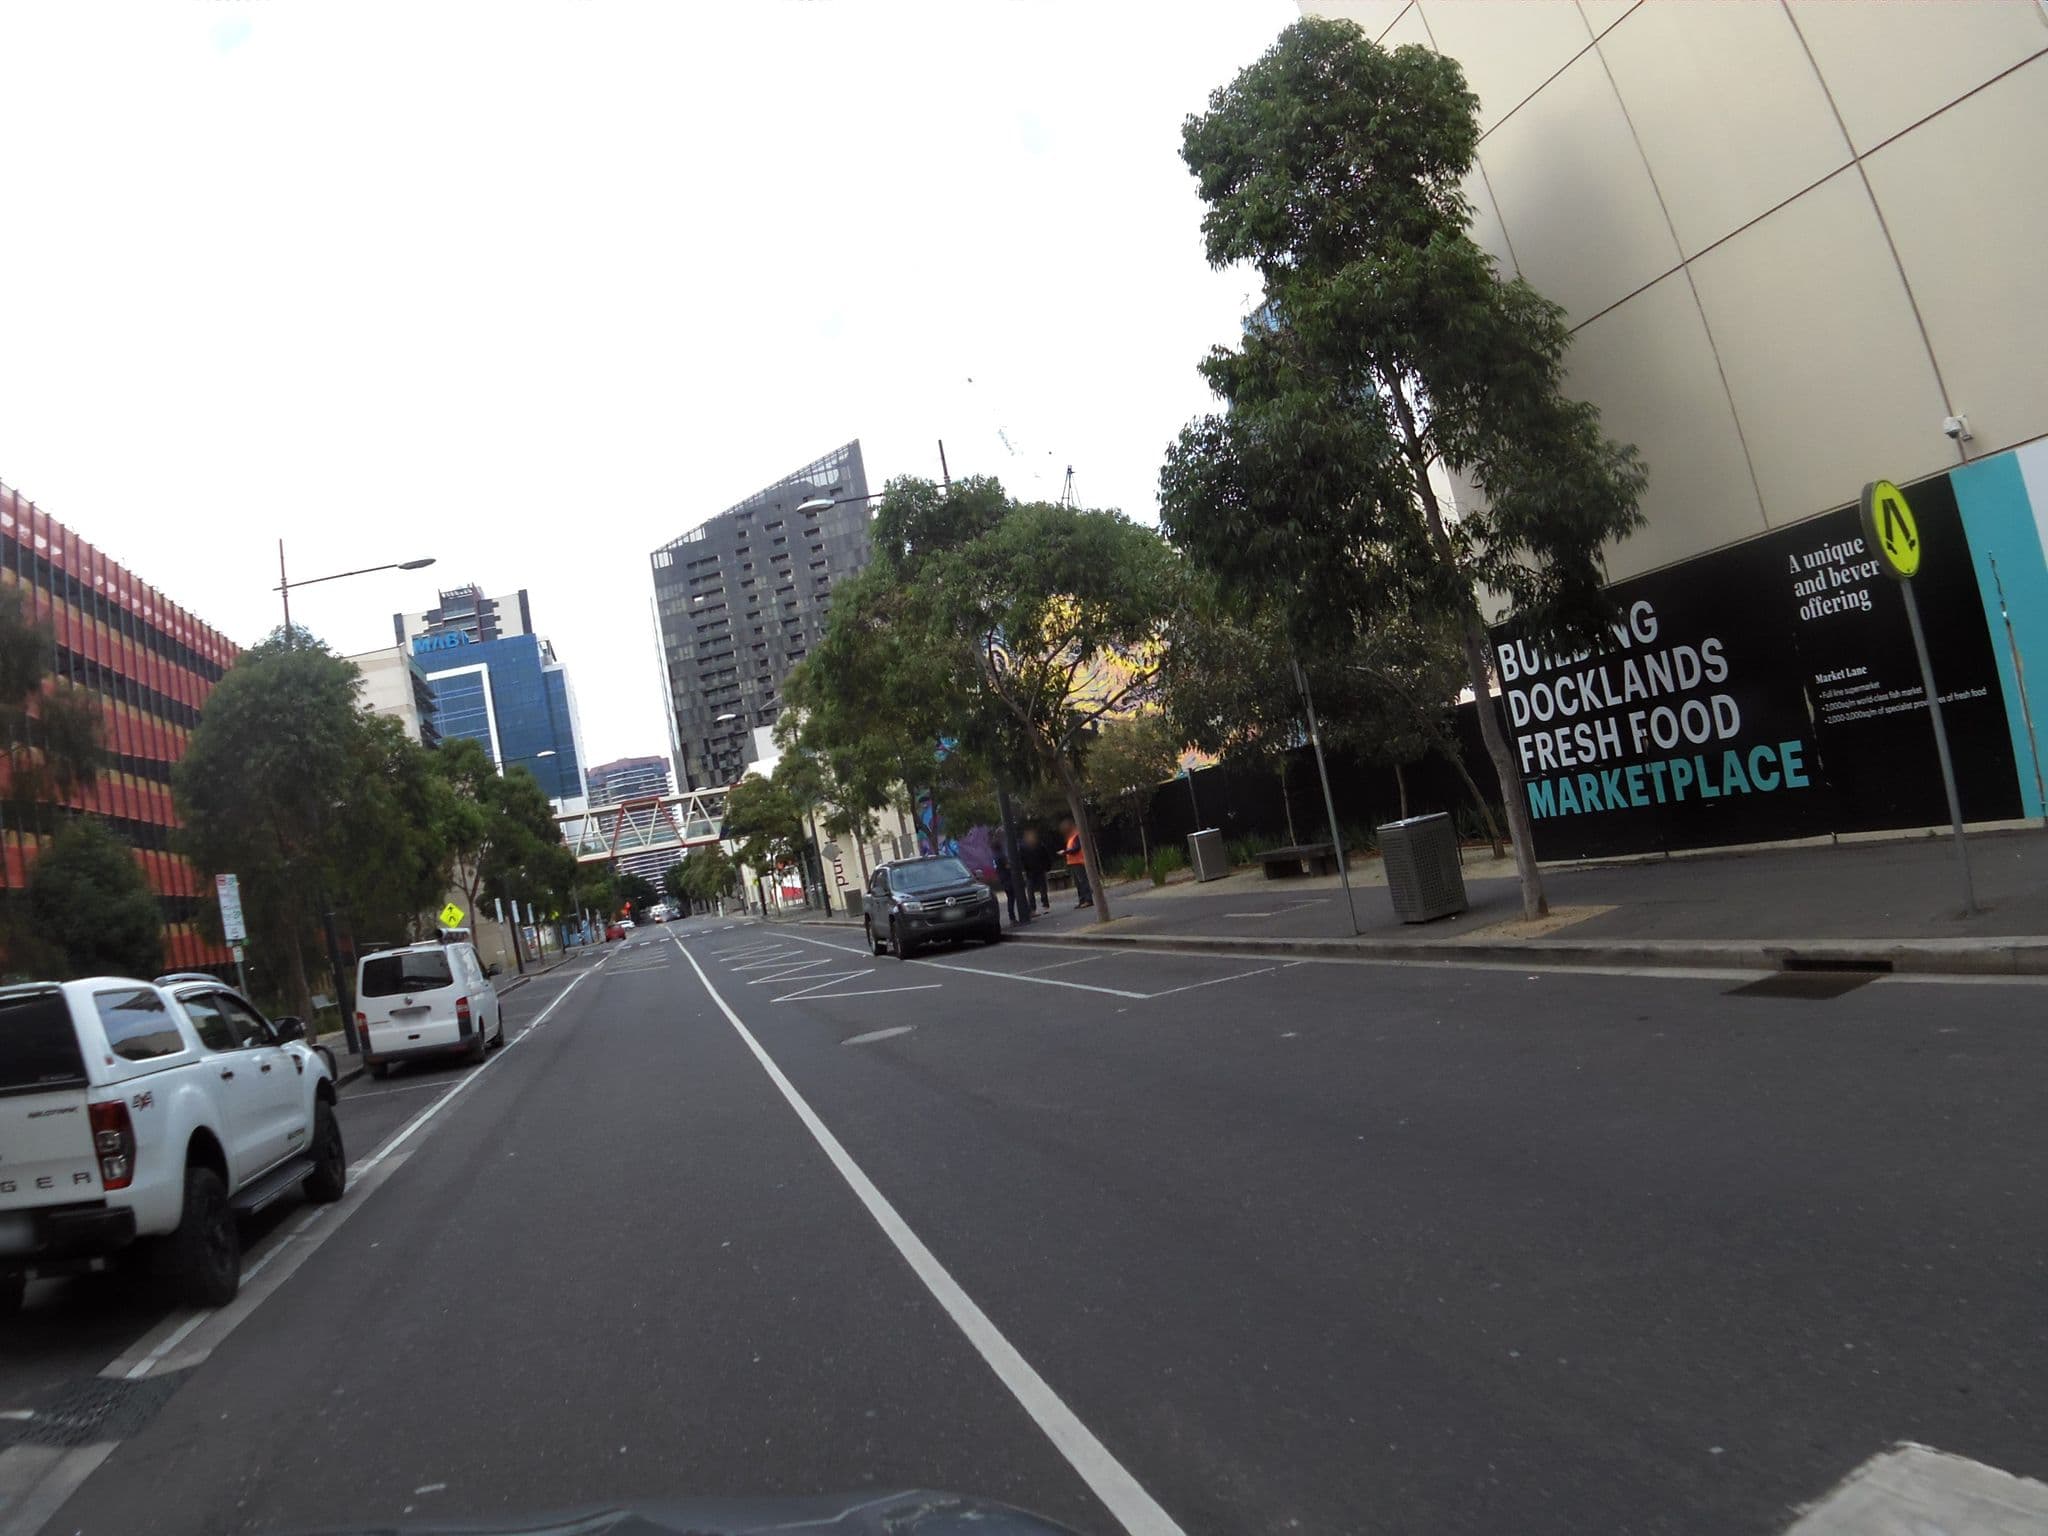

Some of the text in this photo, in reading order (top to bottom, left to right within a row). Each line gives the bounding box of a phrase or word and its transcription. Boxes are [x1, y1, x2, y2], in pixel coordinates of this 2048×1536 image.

[1789, 538, 1865, 574] A unique
[1794, 560, 1881, 597] and bever
[1800, 589, 1873, 621] offering
[1507, 637, 1730, 728] DOCKLANDS
[1815, 666, 1867, 683] Market Lane
[1517, 694, 1742, 774] FRESH FOOD
[1526, 740, 1811, 820] MARKETPLACE
